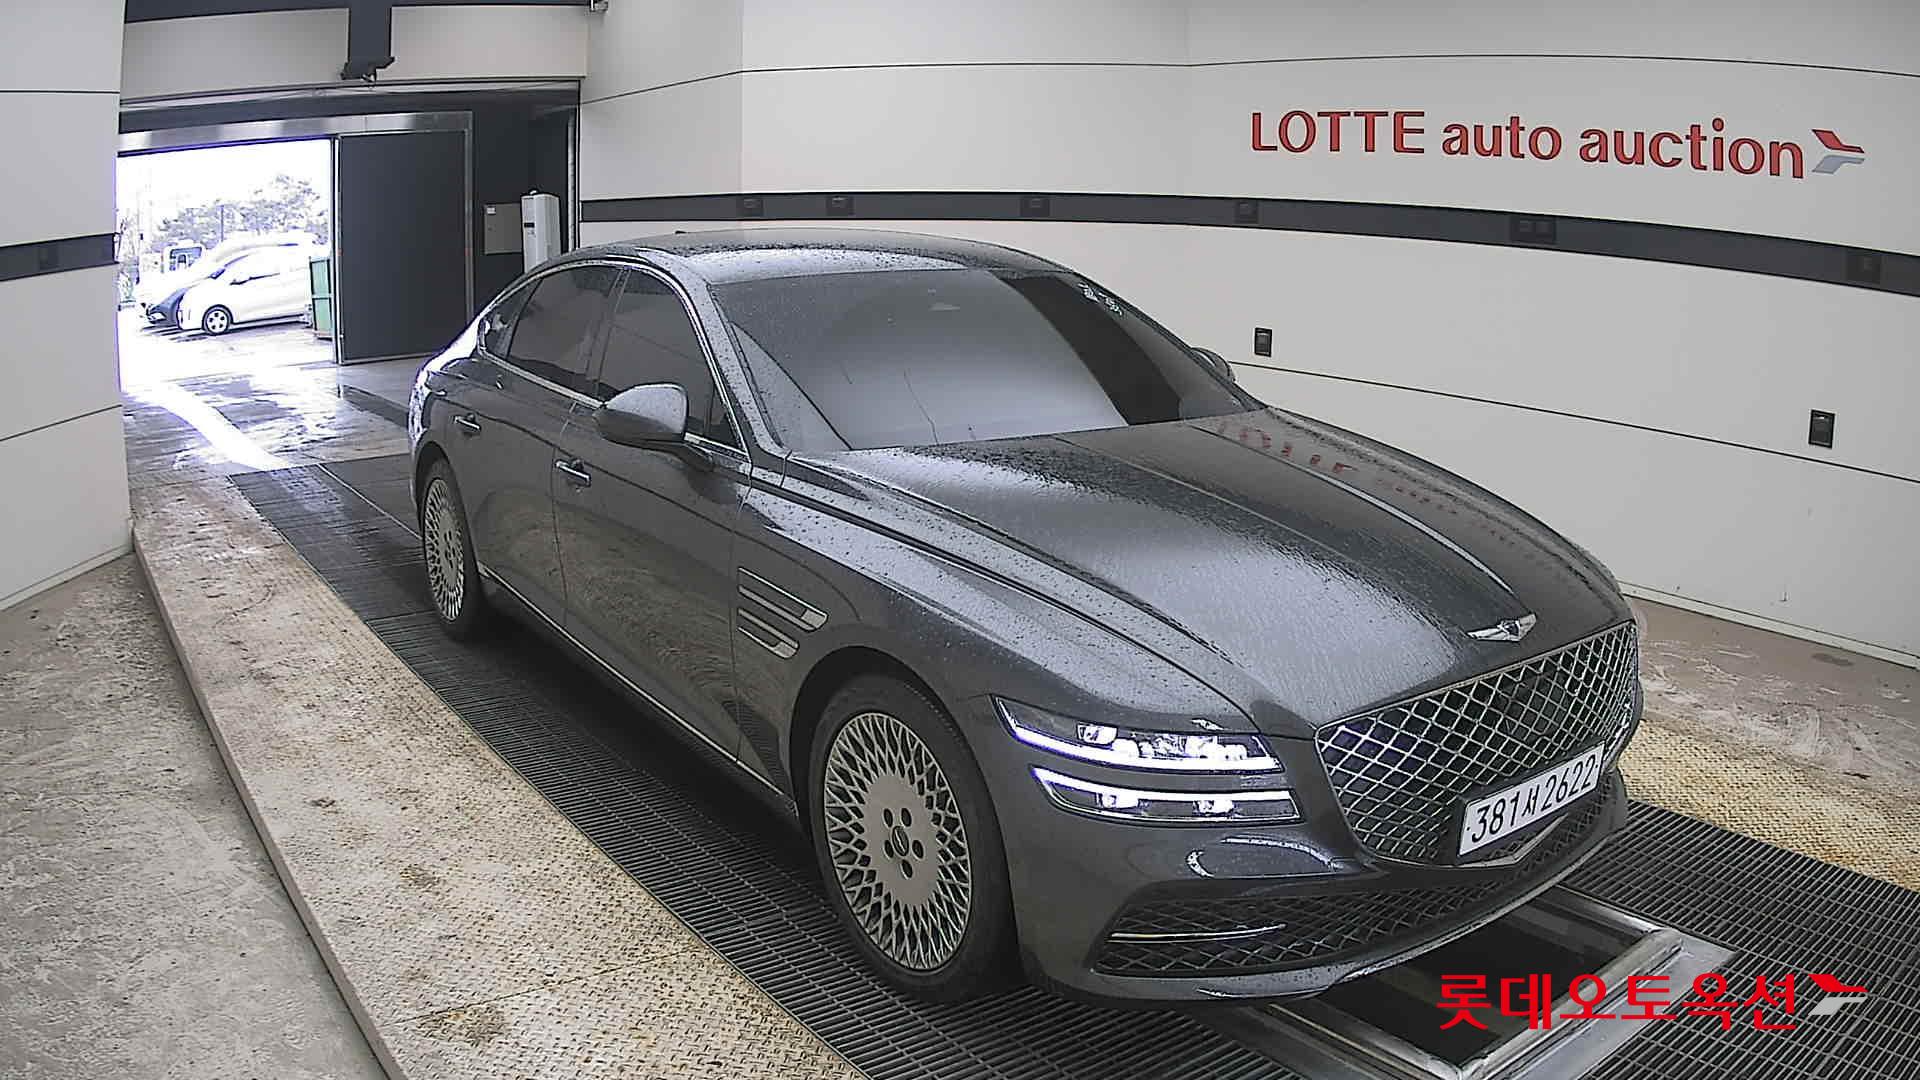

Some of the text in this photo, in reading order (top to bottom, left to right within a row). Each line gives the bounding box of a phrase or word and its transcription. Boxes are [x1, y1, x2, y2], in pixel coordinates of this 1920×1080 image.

[1251, 110, 1804, 179] LOTTE auto auction
